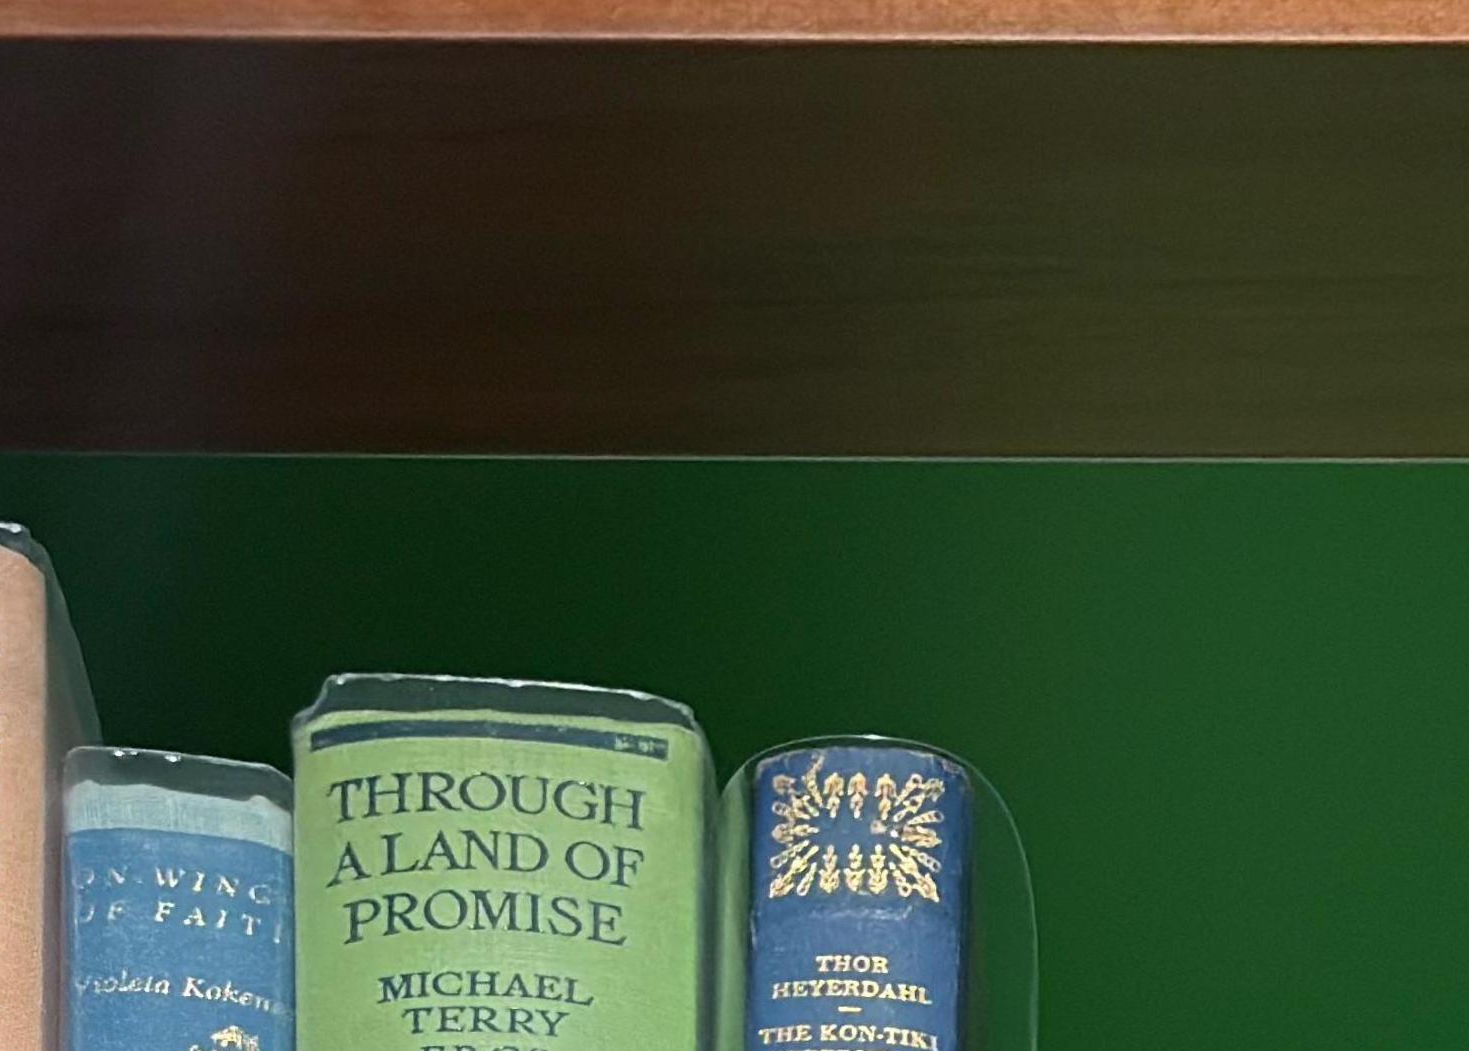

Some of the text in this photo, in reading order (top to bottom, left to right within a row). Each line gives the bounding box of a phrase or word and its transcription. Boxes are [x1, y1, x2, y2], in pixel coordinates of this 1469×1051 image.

[326, 770, 647, 830] THROUGH
[326, 829, 645, 889] A LAND OF
[342, 889, 628, 947] PROMISE
[815, 954, 889, 974] THOR
[377, 969, 595, 1007] MICHAEL
[771, 979, 933, 1005] HEYERDAHL
[402, 1005, 571, 1038] TERRY
[758, 1023, 939, 1051] THE KON-TIKI
